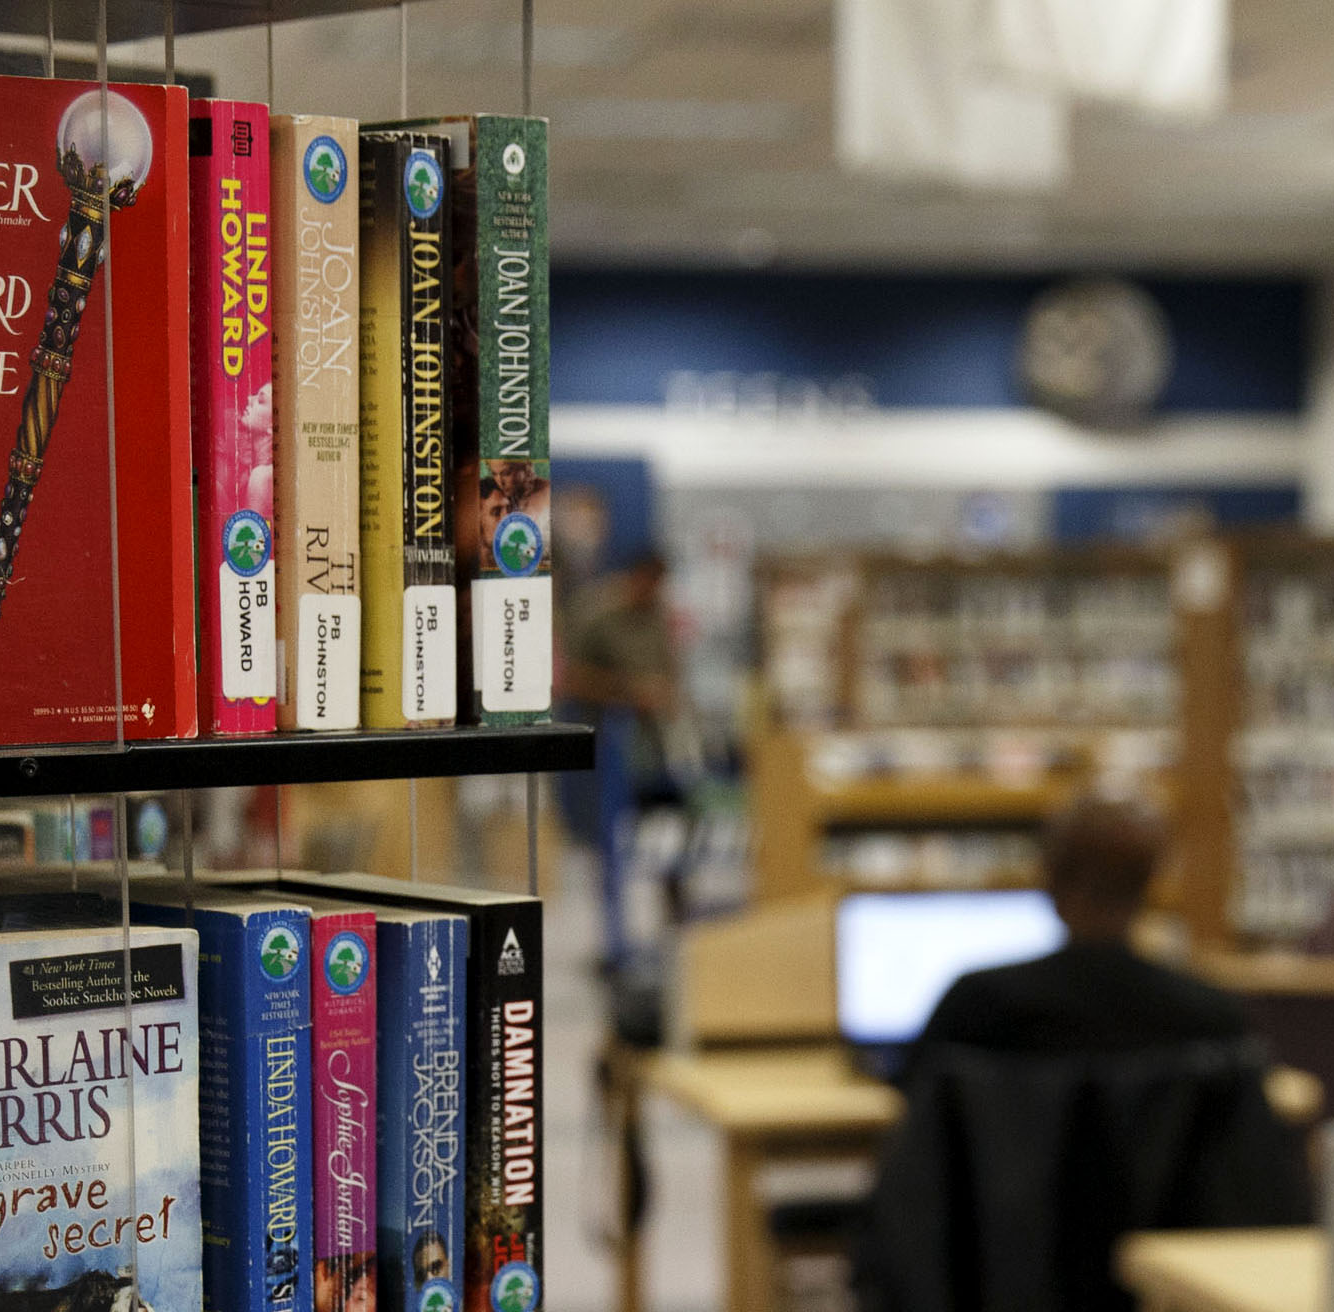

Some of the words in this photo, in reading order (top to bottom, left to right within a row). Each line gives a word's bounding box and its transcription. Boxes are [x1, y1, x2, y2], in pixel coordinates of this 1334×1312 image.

[220, 178, 244, 377] HOWARD
[245, 212, 269, 346] LINDA
[300, 207, 322, 390] JOHNSTON
[322, 222, 355, 375] JOAN
[410, 222, 441, 324] JOAN
[494, 246, 530, 316] JOAN
[411, 325, 442, 538] JOHNSTON
[494, 320, 530, 458] JOHNSTON
[239, 581, 252, 671] HOWARD
[257, 580, 267, 607] PB
[331, 615, 340, 640] PB
[427, 605, 437, 631] PB
[519, 599, 529, 621] PB
[318, 614, 327, 718] JOHNSTON
[415, 606, 424, 712] JOHNSTON
[504, 599, 514, 692] JOHNSTON
[32, 977, 84, 992] Bestselling
[86, 975, 121, 986] Author
[133, 970, 150, 982] the
[40, 963, 62, 974] New
[66, 961, 85, 971] York
[88, 959, 116, 969] Times
[42, 993, 80, 1008] Sookie
[143, 985, 177, 998] Novels
[267, 1034, 297, 1120] LINDA
[321, 1049, 369, 1150] Sophie
[491, 1060, 501, 1088] NOT
[504, 1000, 534, 1206] DAMNATION
[412, 1053, 435, 1228] JACKSON
[433, 1050, 459, 1204] BRENDA
[491, 1115, 501, 1171] REASON
[43, 1195, 176, 1259] secret
[267, 1122, 298, 1244] HOWARD
